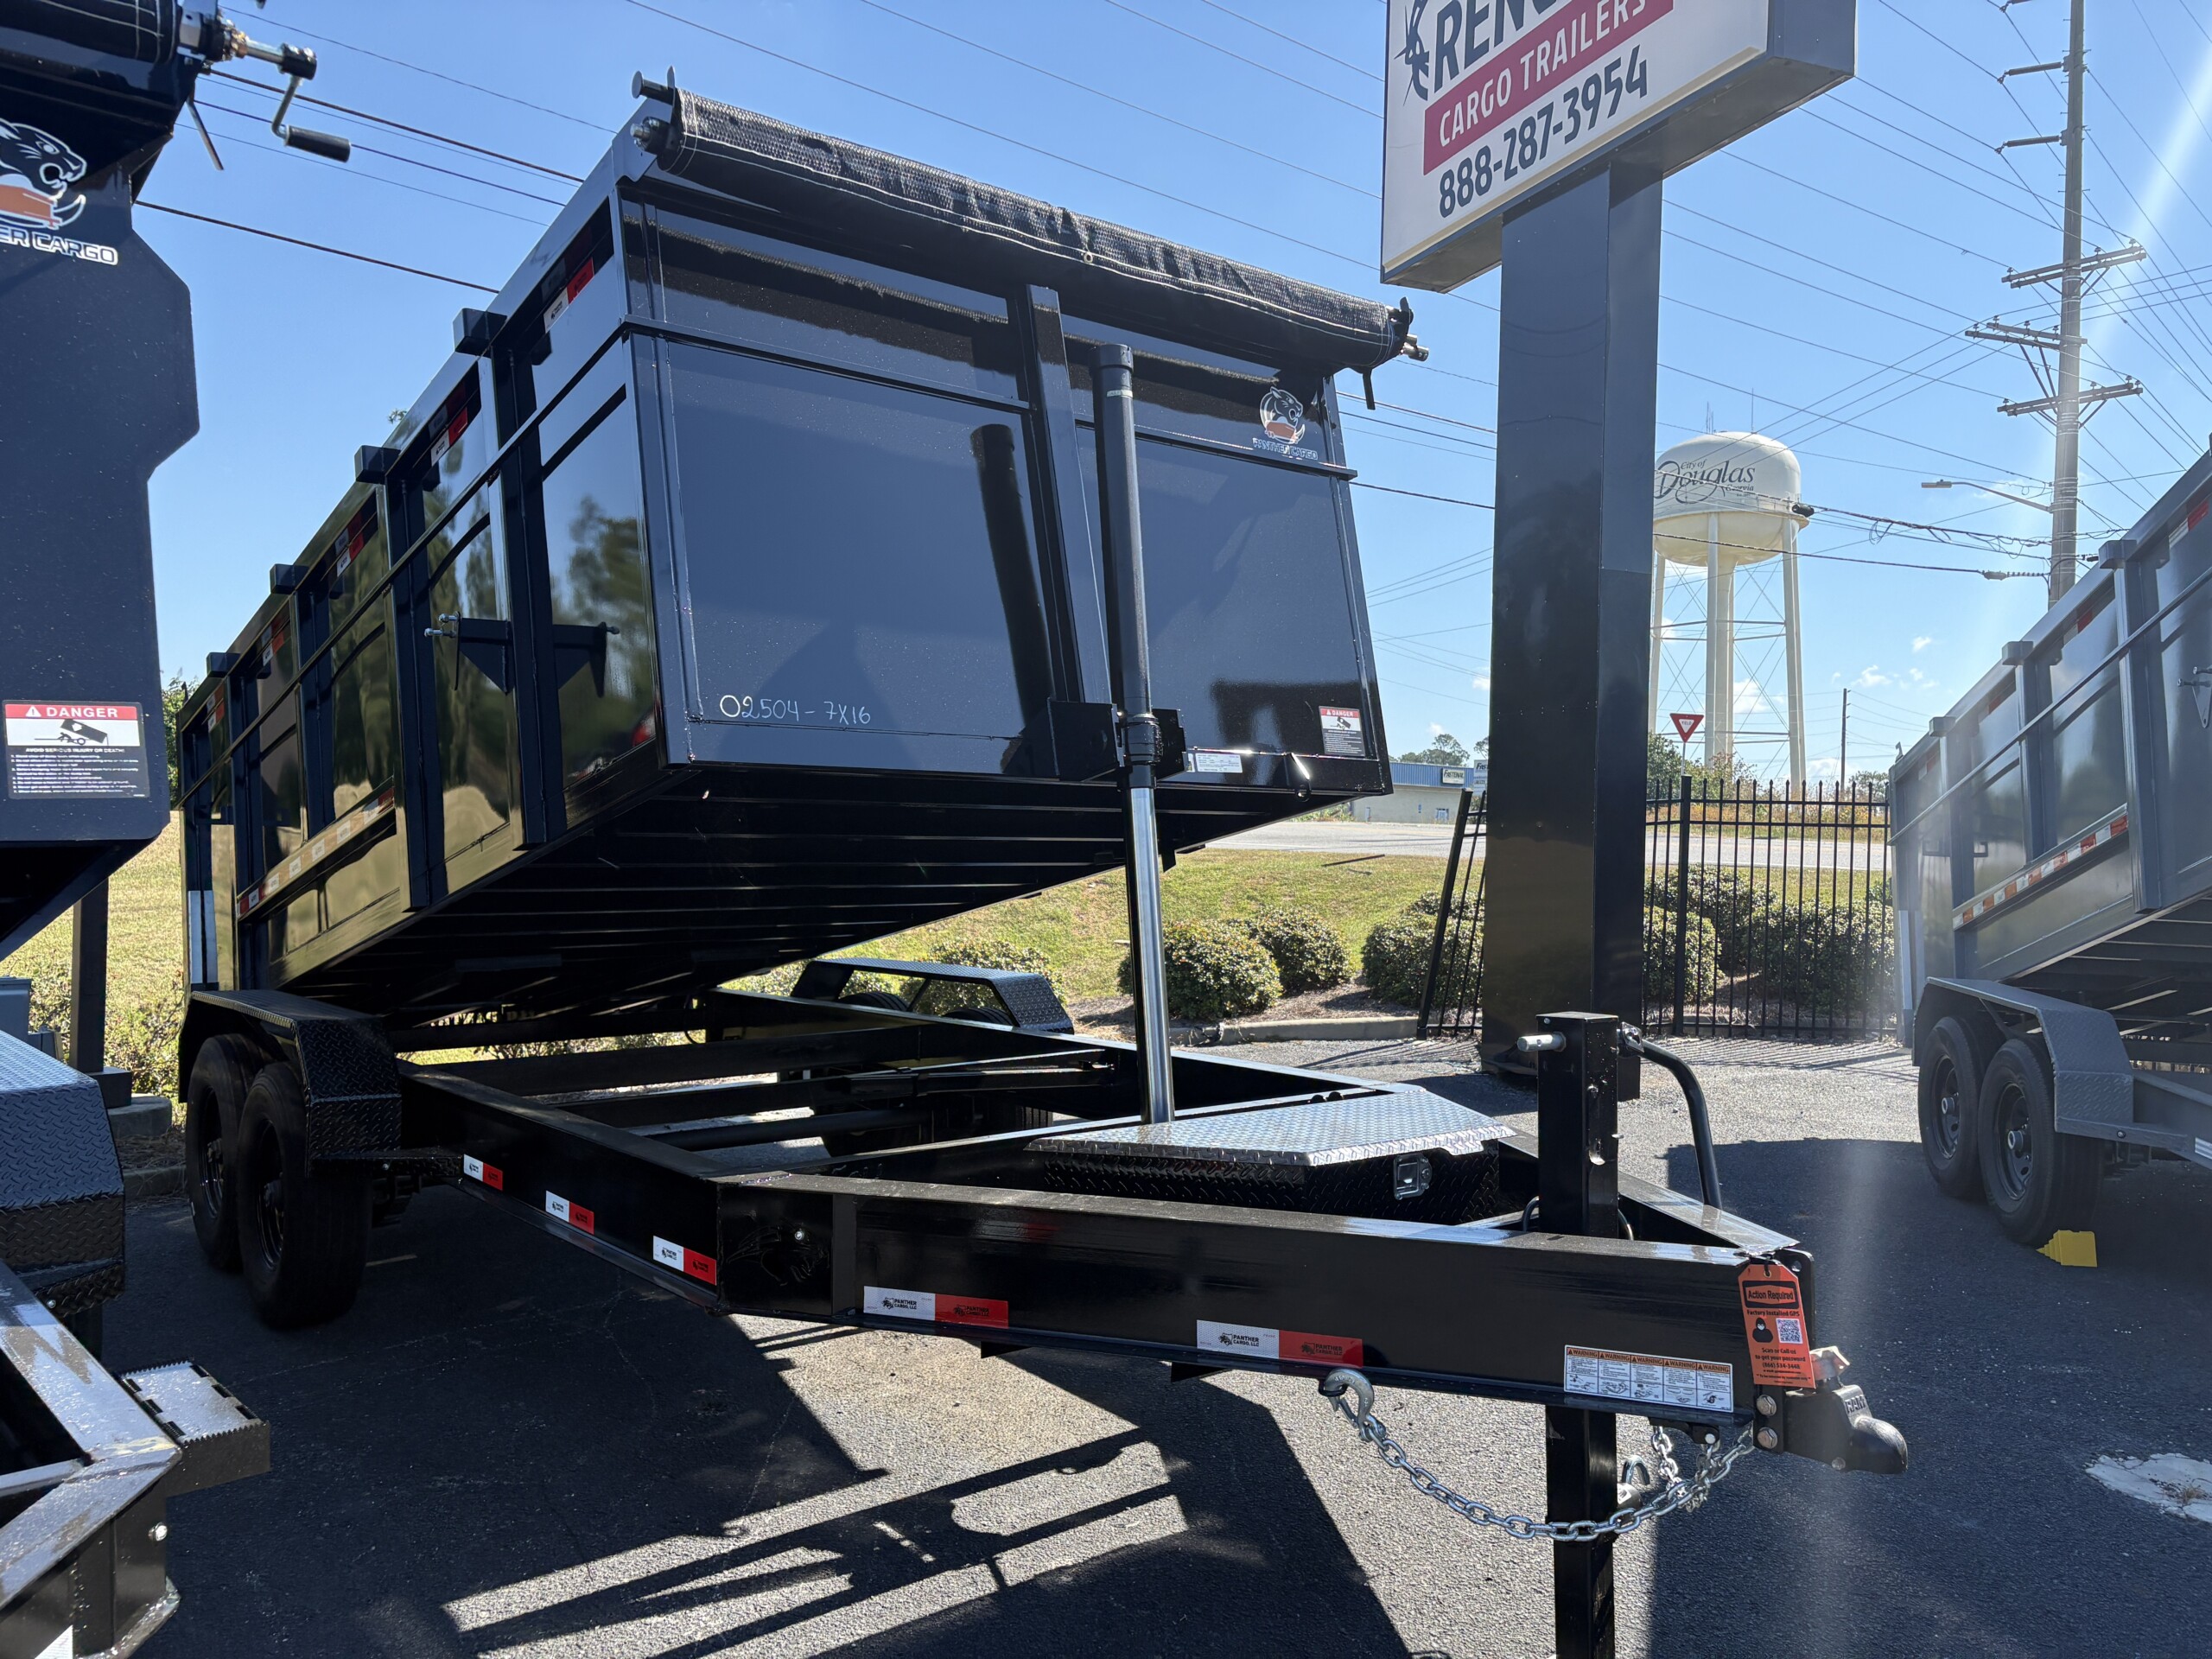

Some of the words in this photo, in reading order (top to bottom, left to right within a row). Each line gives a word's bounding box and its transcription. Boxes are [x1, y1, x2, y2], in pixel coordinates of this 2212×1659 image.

[1434, 0, 1556, 93] REN
[1439, 67, 1511, 147] CARGO
[1439, 44, 1648, 218] 888-287-3954
[32, 232, 118, 266] CARGO
[1252, 437, 1290, 455] PANTHER
[1289, 445, 1319, 461] CARGO
[1681, 461, 1695, 471] City
[1698, 459, 1708, 469] of
[1654, 461, 1756, 504] Douglas
[46, 706, 118, 718] DANGER
[1444, 770, 1465, 779] FASTENAL
[1748, 1290, 1767, 1299] Action
[1767, 1291, 1794, 1302] Required
[1637, 1356, 1662, 1364] WARNING
